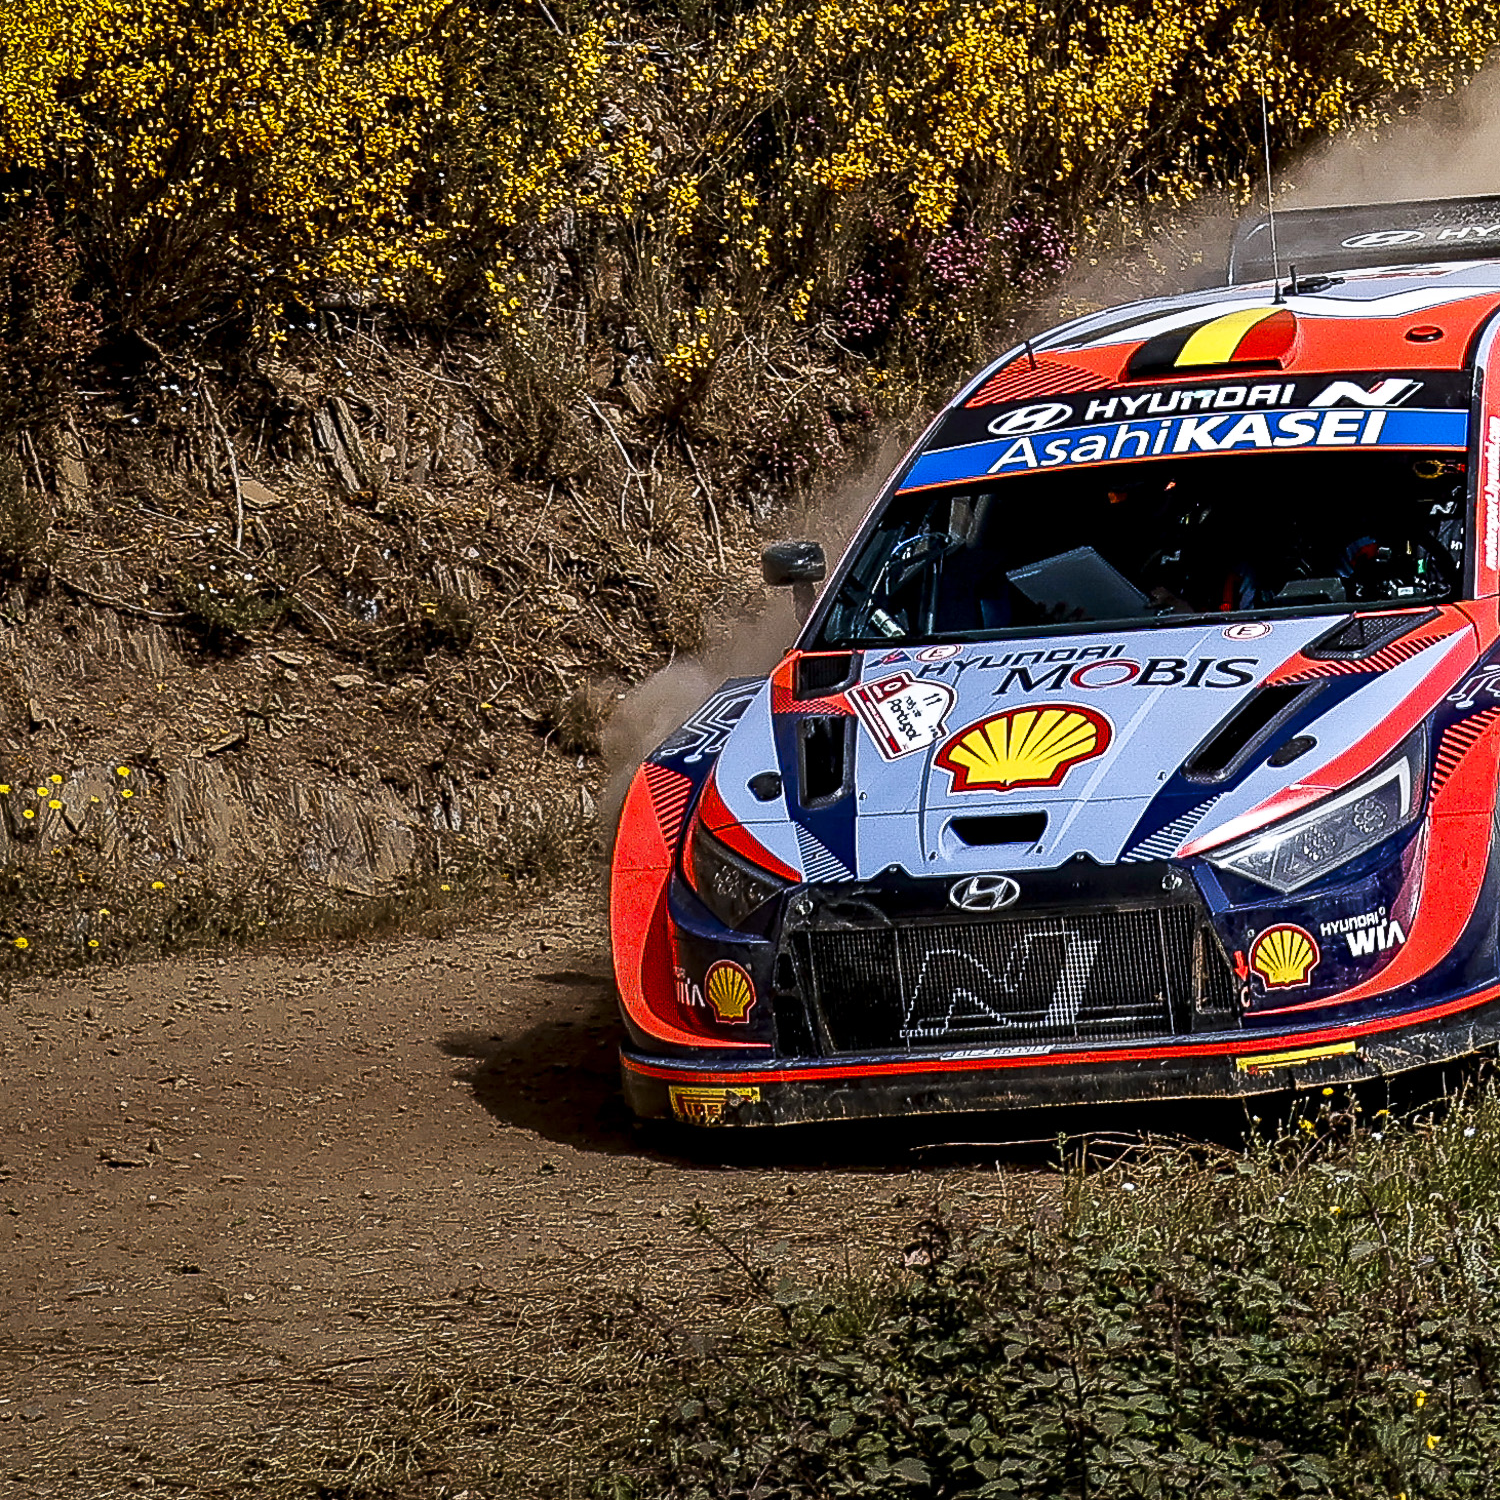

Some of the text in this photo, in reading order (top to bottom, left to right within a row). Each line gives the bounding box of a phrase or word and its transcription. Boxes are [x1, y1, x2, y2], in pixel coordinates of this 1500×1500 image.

[1084, 383, 1295, 422] HYUNDAI
[916, 644, 1126, 680] HYUNDAI
[994, 657, 1261, 697] MOBIS
[1319, 910, 1379, 937] HYUNDAI
